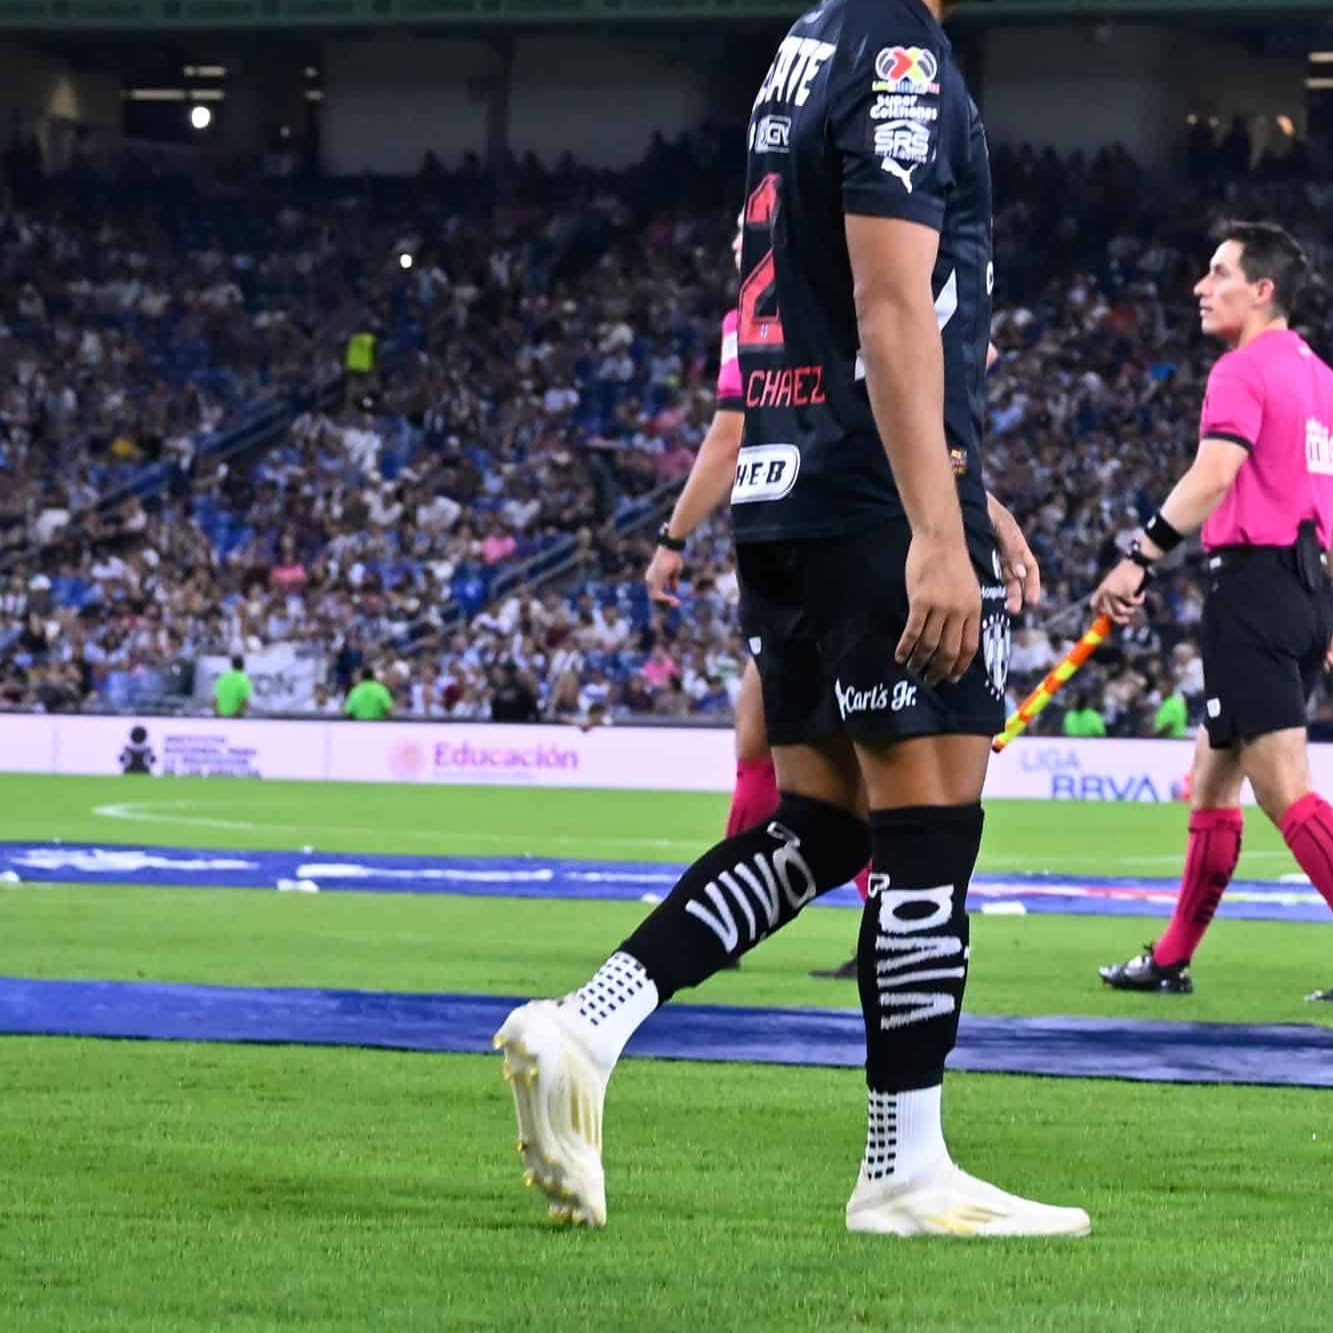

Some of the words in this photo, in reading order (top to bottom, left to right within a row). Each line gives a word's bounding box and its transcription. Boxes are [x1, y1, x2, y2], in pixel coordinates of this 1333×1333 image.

[752, 35, 837, 107] CATE
[891, 680, 918, 713] Jr.
[434, 741, 578, 770] Educación
[1022, 749, 1079, 770] LIGA
[1051, 774, 1160, 803] BBVA
